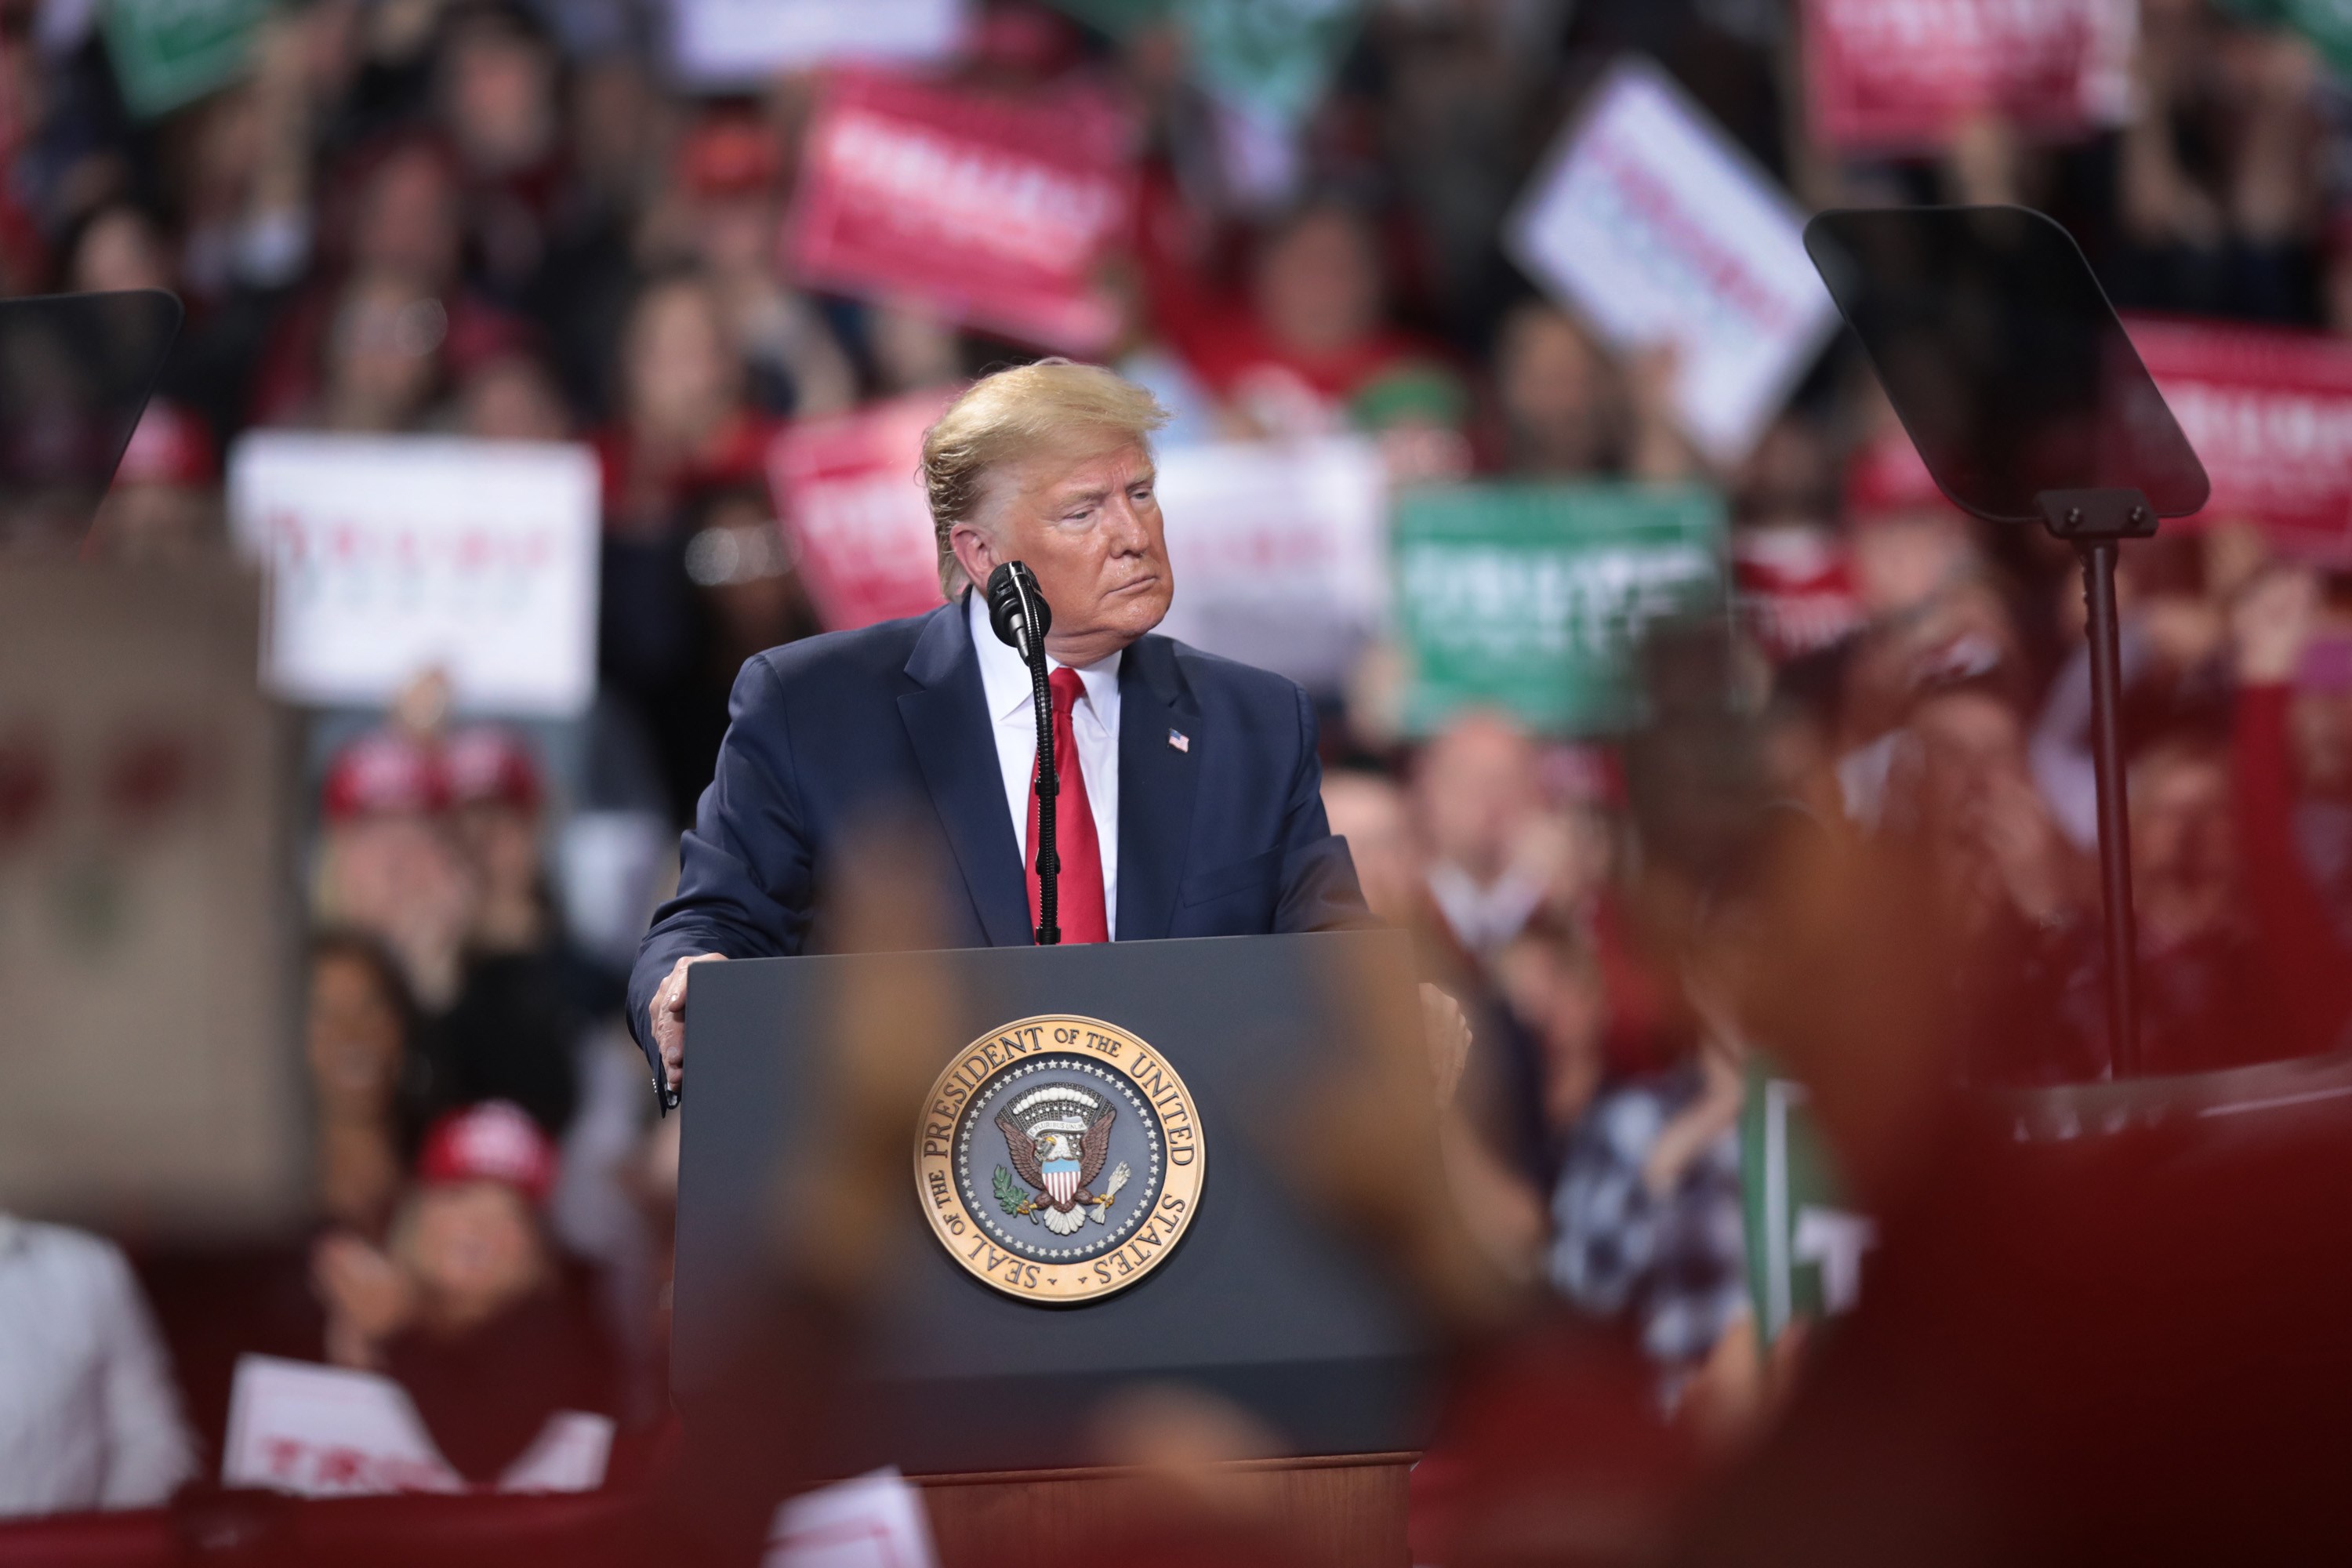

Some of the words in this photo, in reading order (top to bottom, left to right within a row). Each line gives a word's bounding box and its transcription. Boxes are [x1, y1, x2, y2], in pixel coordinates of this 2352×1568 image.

[1054, 1028, 1080, 1044] OF
[1087, 1031, 1122, 1058] THE
[924, 1025, 1044, 1159] PRESIDENT
[1130, 1052, 1195, 1166] UNITED
[1033, 1121, 1065, 1132] PLURIBUS
[928, 1169, 953, 1209] THE
[942, 1213, 966, 1236] OF
[1093, 1193, 1185, 1284] STATES
[967, 1233, 1041, 1289] SEAL
